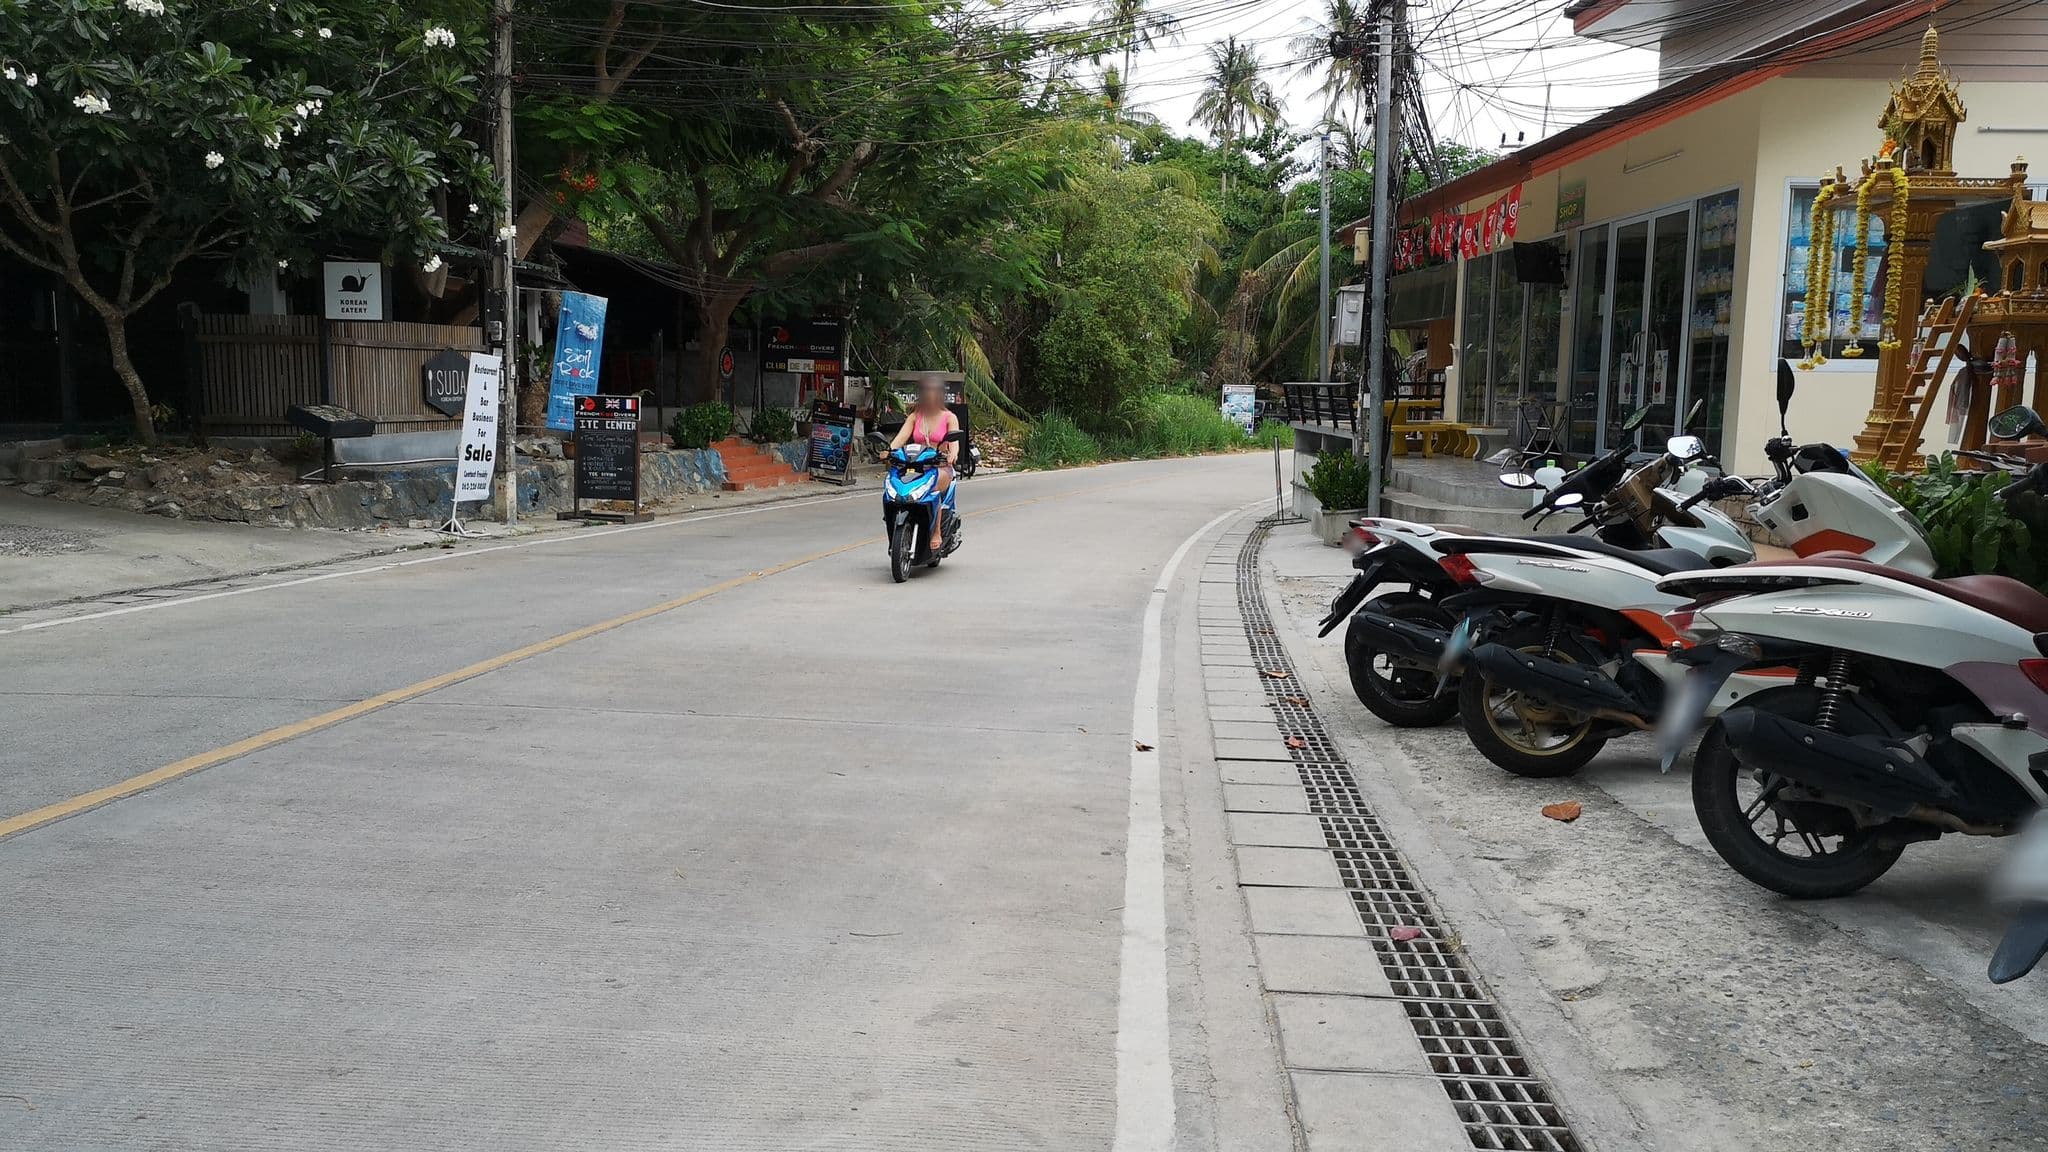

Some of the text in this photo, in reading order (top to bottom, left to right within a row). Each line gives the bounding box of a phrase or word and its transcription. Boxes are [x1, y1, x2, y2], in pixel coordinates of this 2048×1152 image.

[1559, 203, 1578, 219] SHOP
[474, 364, 498, 376] Restaurant
[766, 361, 786, 369] CLUB
[436, 369, 467, 395] SUDA
[480, 396, 489, 406] Bar
[472, 411, 494, 423] Business
[580, 420, 637, 431] ITC CENTER
[478, 428, 486, 438] For
[464, 444, 492, 462] Sale
